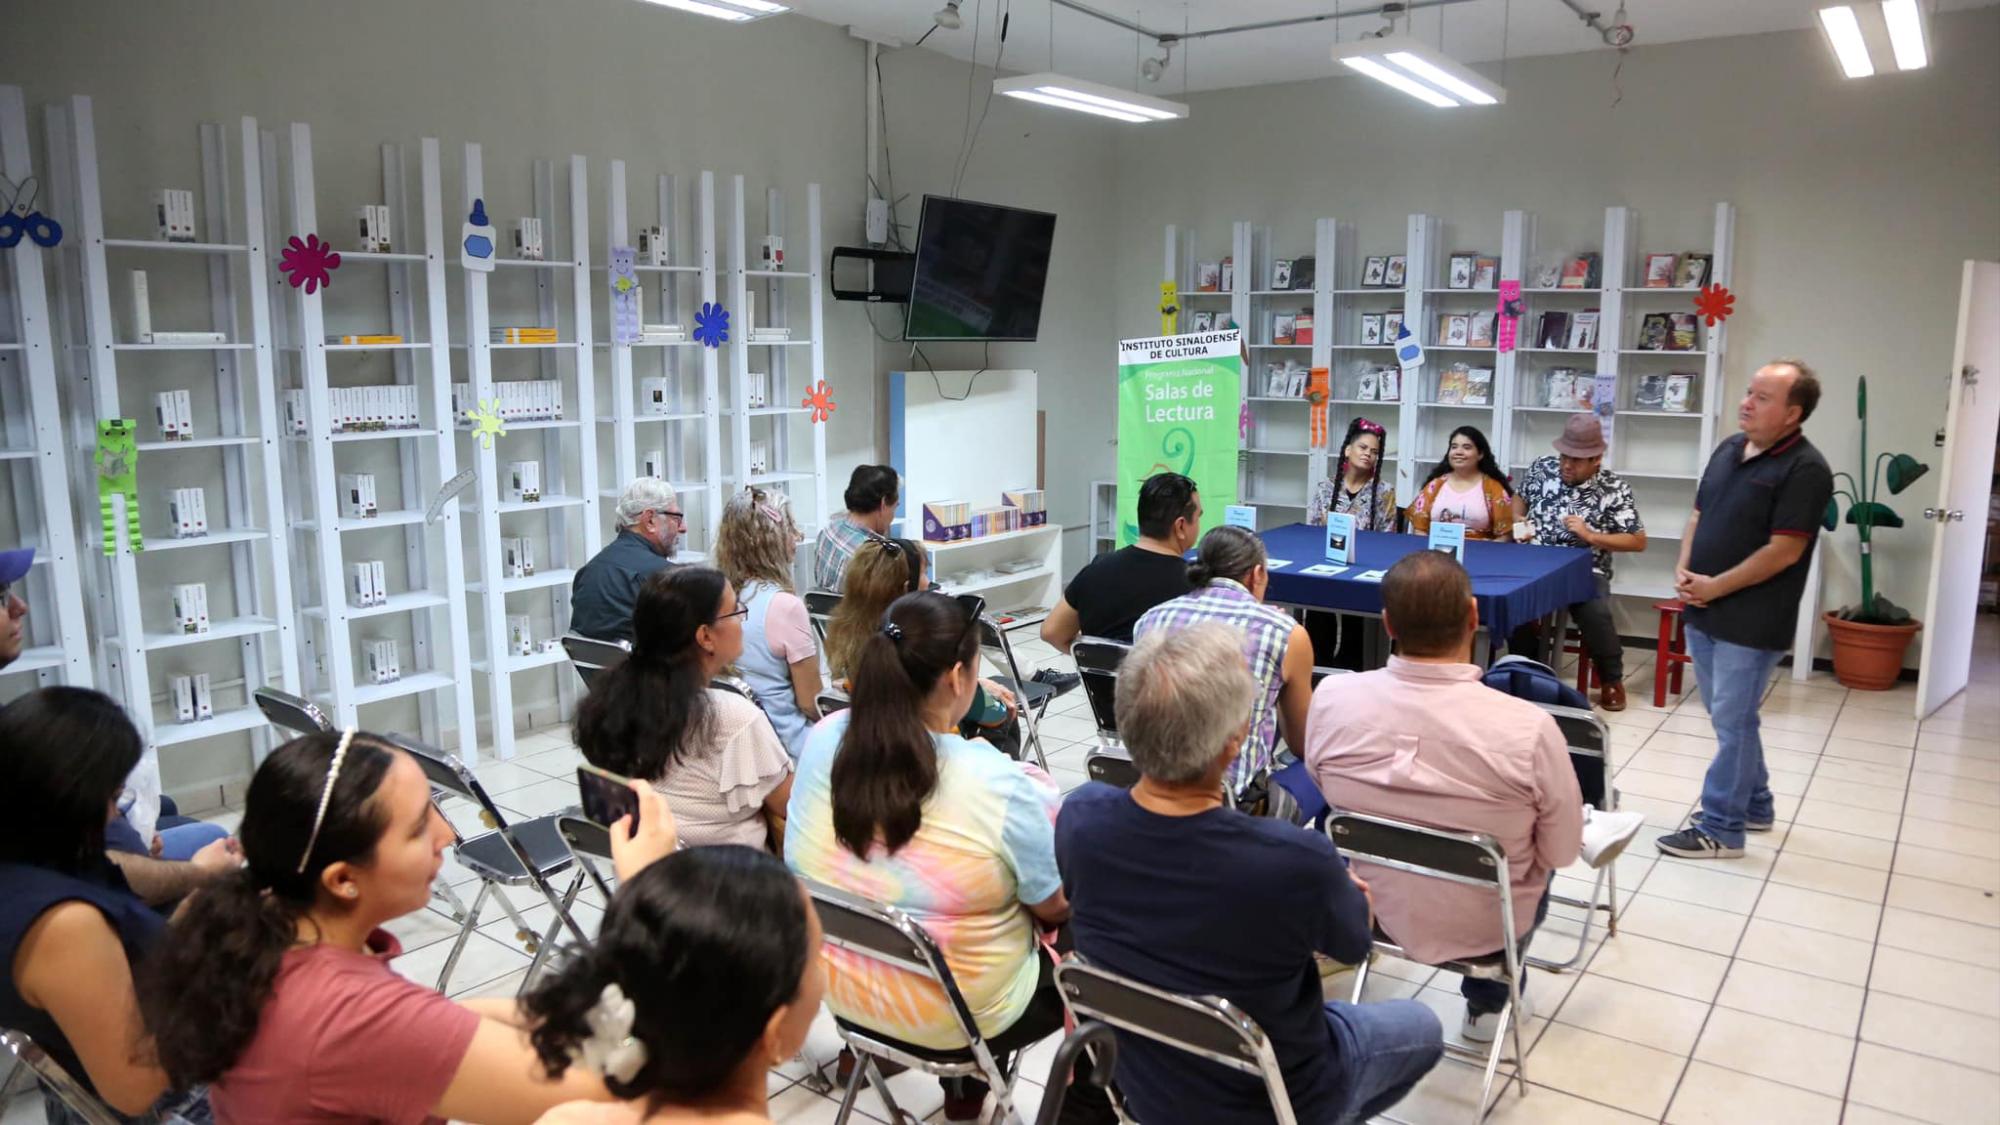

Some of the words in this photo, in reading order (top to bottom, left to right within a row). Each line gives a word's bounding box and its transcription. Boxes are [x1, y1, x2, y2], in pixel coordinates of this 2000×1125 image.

[1121, 339, 1173, 351] INSTITUTO
[1176, 333, 1238, 346] SINALOENSE
[1150, 350, 1163, 359] DE
[1165, 346, 1208, 358] CULTURA
[1145, 382, 1188, 401] Salas
[1192, 380, 1213, 398] de
[1146, 404, 1214, 422] Lectura
